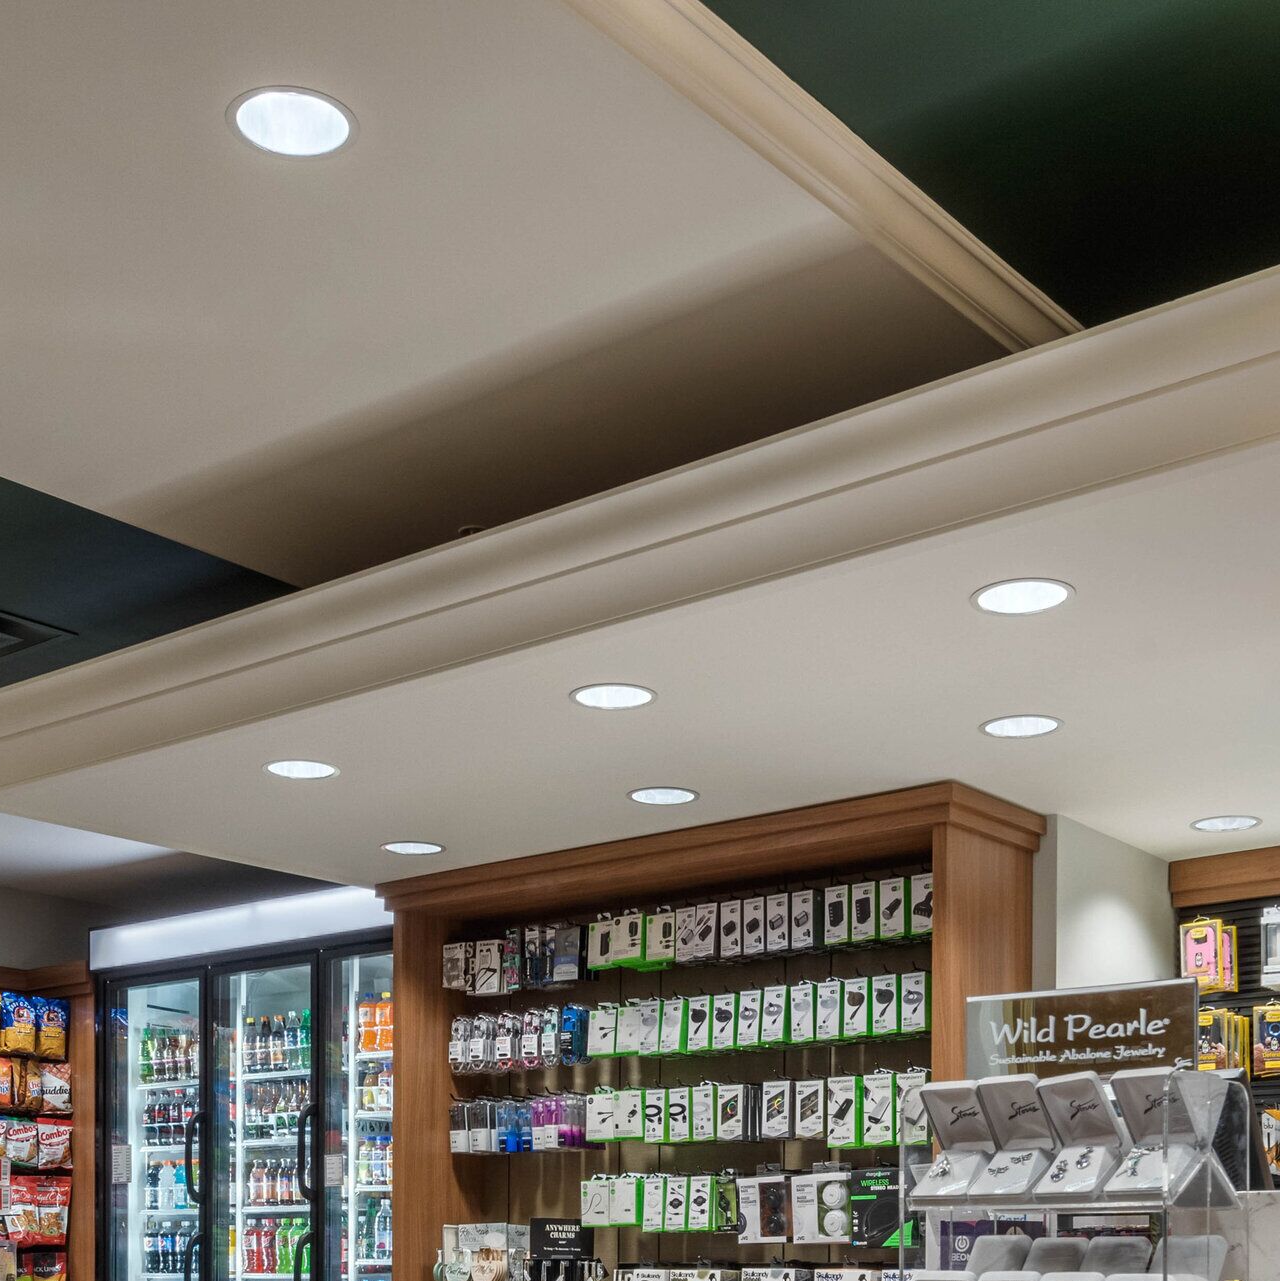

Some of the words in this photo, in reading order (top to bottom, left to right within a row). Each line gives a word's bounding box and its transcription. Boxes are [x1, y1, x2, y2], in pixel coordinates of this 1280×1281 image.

[989, 1015, 1057, 1046] Wild
[1064, 1008, 1167, 1042] Pearle
[989, 1050, 1057, 1066] Sustainable
[1059, 1047, 1112, 1063] Abalone
[1113, 1043, 1167, 1061] Jewelry
[28, 1081, 41, 1091] Che
[41, 1086, 70, 1097] uddie
[7, 1123, 38, 1136] Combos
[1263, 1119, 1274, 1130] blu
[861, 1179, 890, 1188] WIRELESS
[545, 1224, 581, 1232] ANYWHERE
[549, 1232, 575, 1240] CHARMS
[670, 1271, 696, 1281] Skullcandy
[742, 1271, 769, 1281] Skullcandy
